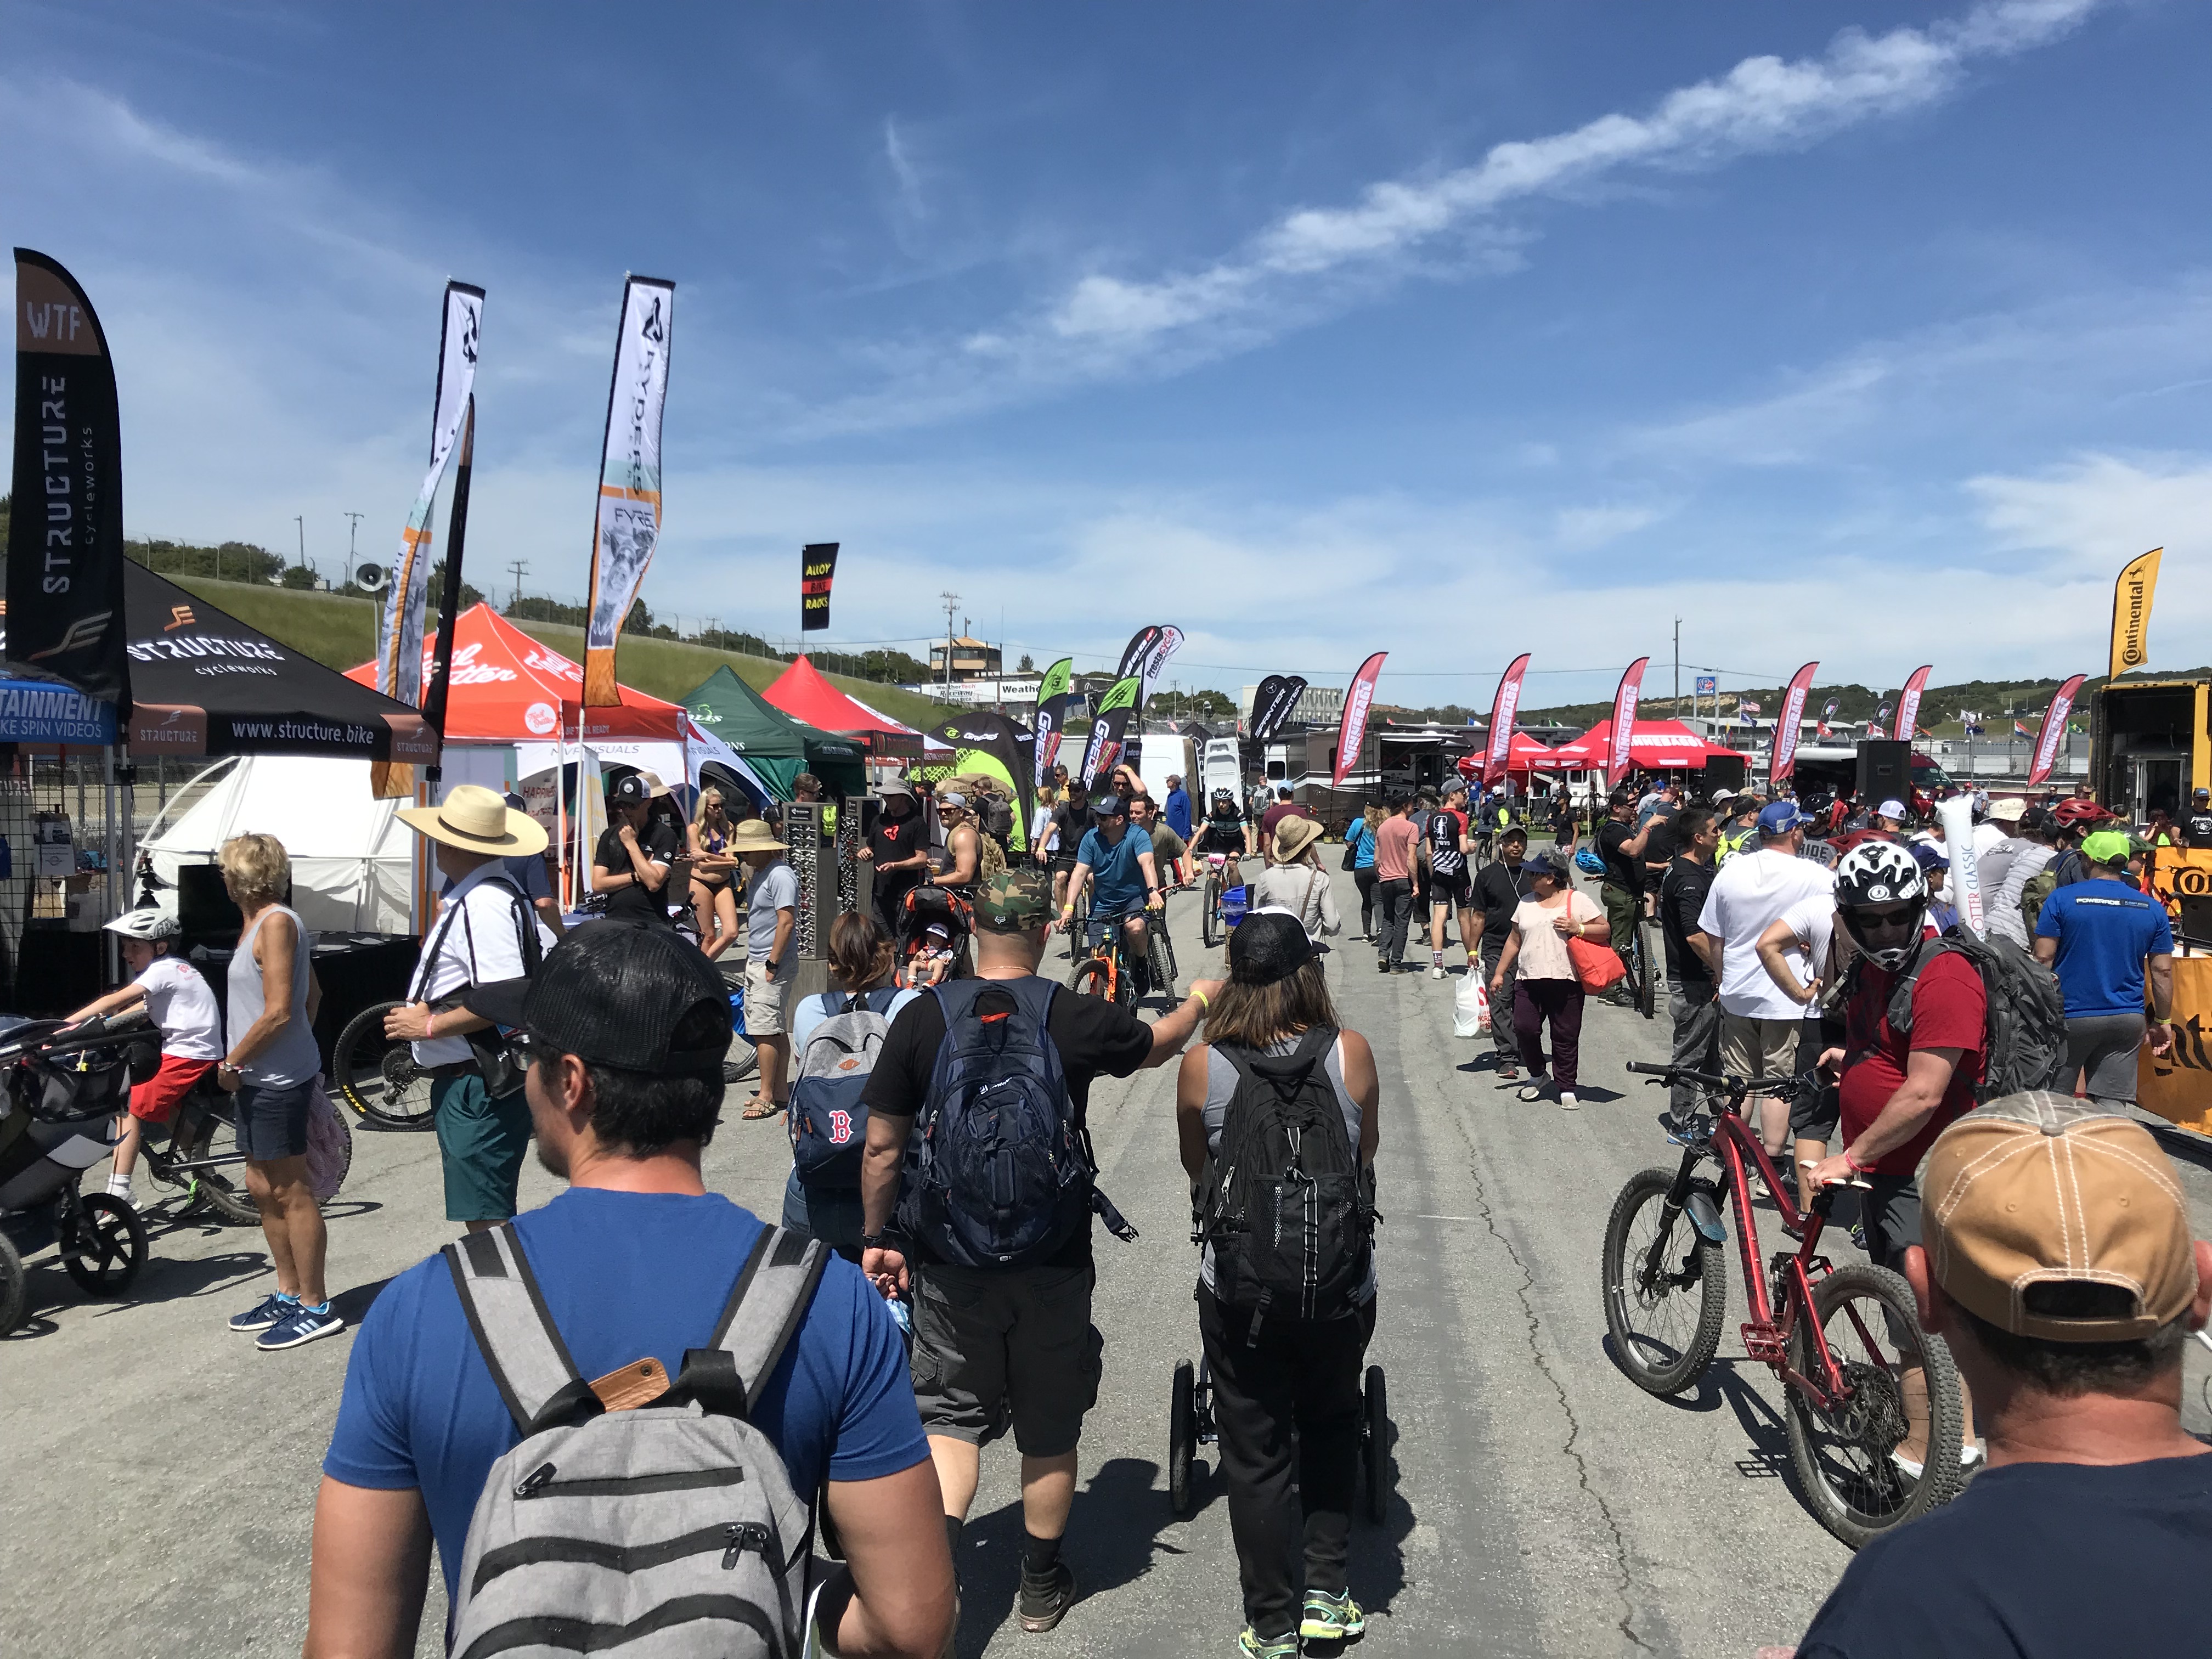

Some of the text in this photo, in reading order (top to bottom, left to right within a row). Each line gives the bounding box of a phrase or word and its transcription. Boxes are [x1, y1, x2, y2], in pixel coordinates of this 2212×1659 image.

[26, 301, 81, 341] WTF
[42, 376, 72, 594] STRUCTURE
[80, 426, 95, 545] cycleworks
[805, 563, 832, 576] ALLOY
[805, 596, 828, 610] RACKS
[810, 582, 826, 593] BIKE
[2122, 579, 2145, 665] Continental
[126, 636, 286, 662] STRUCTURE
[1146, 629, 1175, 679] Prestacycle
[194, 662, 278, 676] cycleworks
[1255, 688, 1286, 738] SPRINTER
[1273, 685, 1302, 731] SPRINTER
[1341, 678, 1373, 769] WINNEBAGO
[1491, 681, 1519, 765] WINNEBAGO
[21, 720, 51, 736] SPIN
[55, 722, 102, 738] VIDEOS
[140, 729, 198, 743] STRUCTURE
[232, 719, 375, 745] www.structure.bike
[1602, 735, 1706, 748] INNEBAGO
[1615, 684, 1638, 769] WINNEBAGO
[1778, 686, 1806, 768] WINNEBAGO
[2036, 695, 2070, 772] WINNEBAGO
[396, 741, 433, 754] STRUCTURE
[591, 745, 640, 754] ISUALS
[1898, 876, 1923, 900] BELL
[1960, 845, 1985, 931] OTTER CLASSIC
[342, 1085, 366, 1113] MAXXIS
[829, 1110, 854, 1144] B
